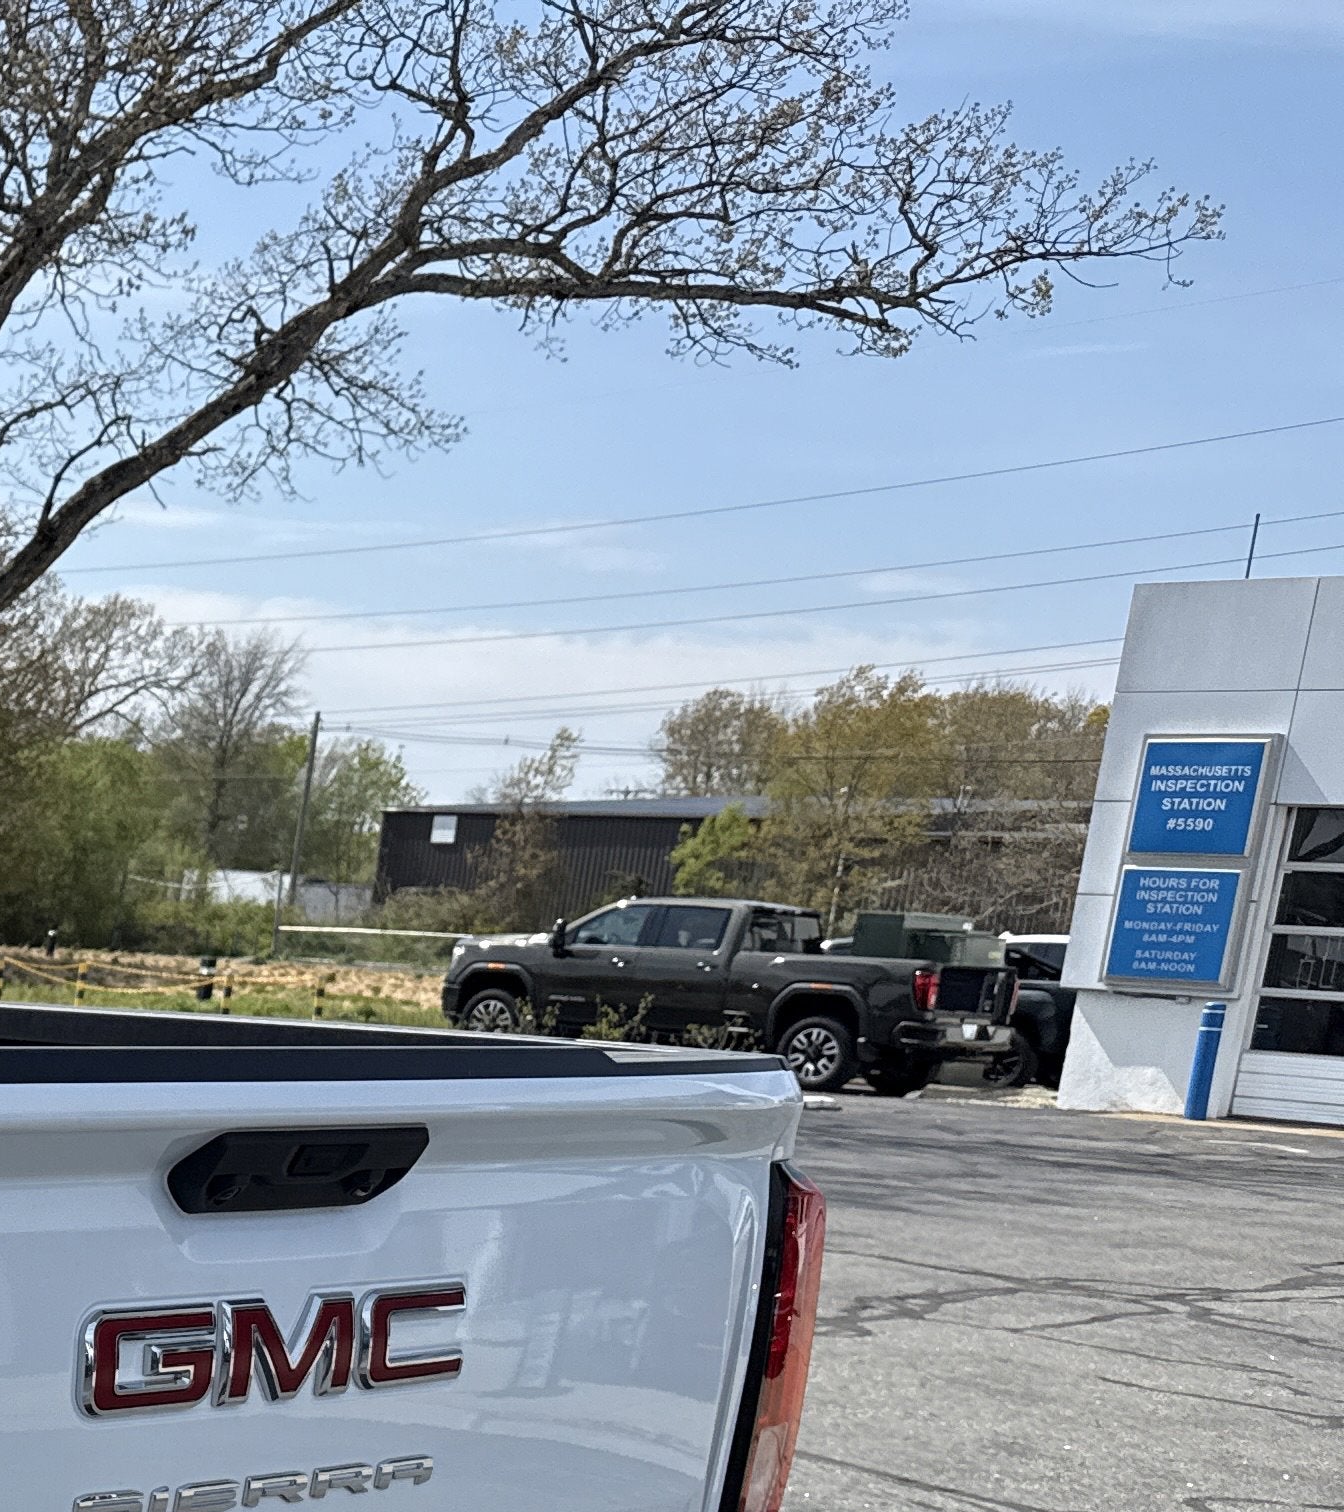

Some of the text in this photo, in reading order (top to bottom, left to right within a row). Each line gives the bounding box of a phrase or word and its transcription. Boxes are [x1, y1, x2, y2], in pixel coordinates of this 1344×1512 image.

[1149, 765, 1252, 777] MASSACHUSETTS
[1151, 779, 1246, 793] INSPECTION
[1161, 797, 1227, 811] STATION
[1166, 817, 1214, 831] #5590
[1139, 877, 1221, 890] HOURS FOR
[1135, 890, 1218, 903] INSPECTION
[1146, 902, 1204, 915] STATION
[1123, 920, 1220, 933] MONDAY-FRIDAY
[1135, 949, 1198, 961] SATURDAY
[78, 1281, 466, 1418] GMC
